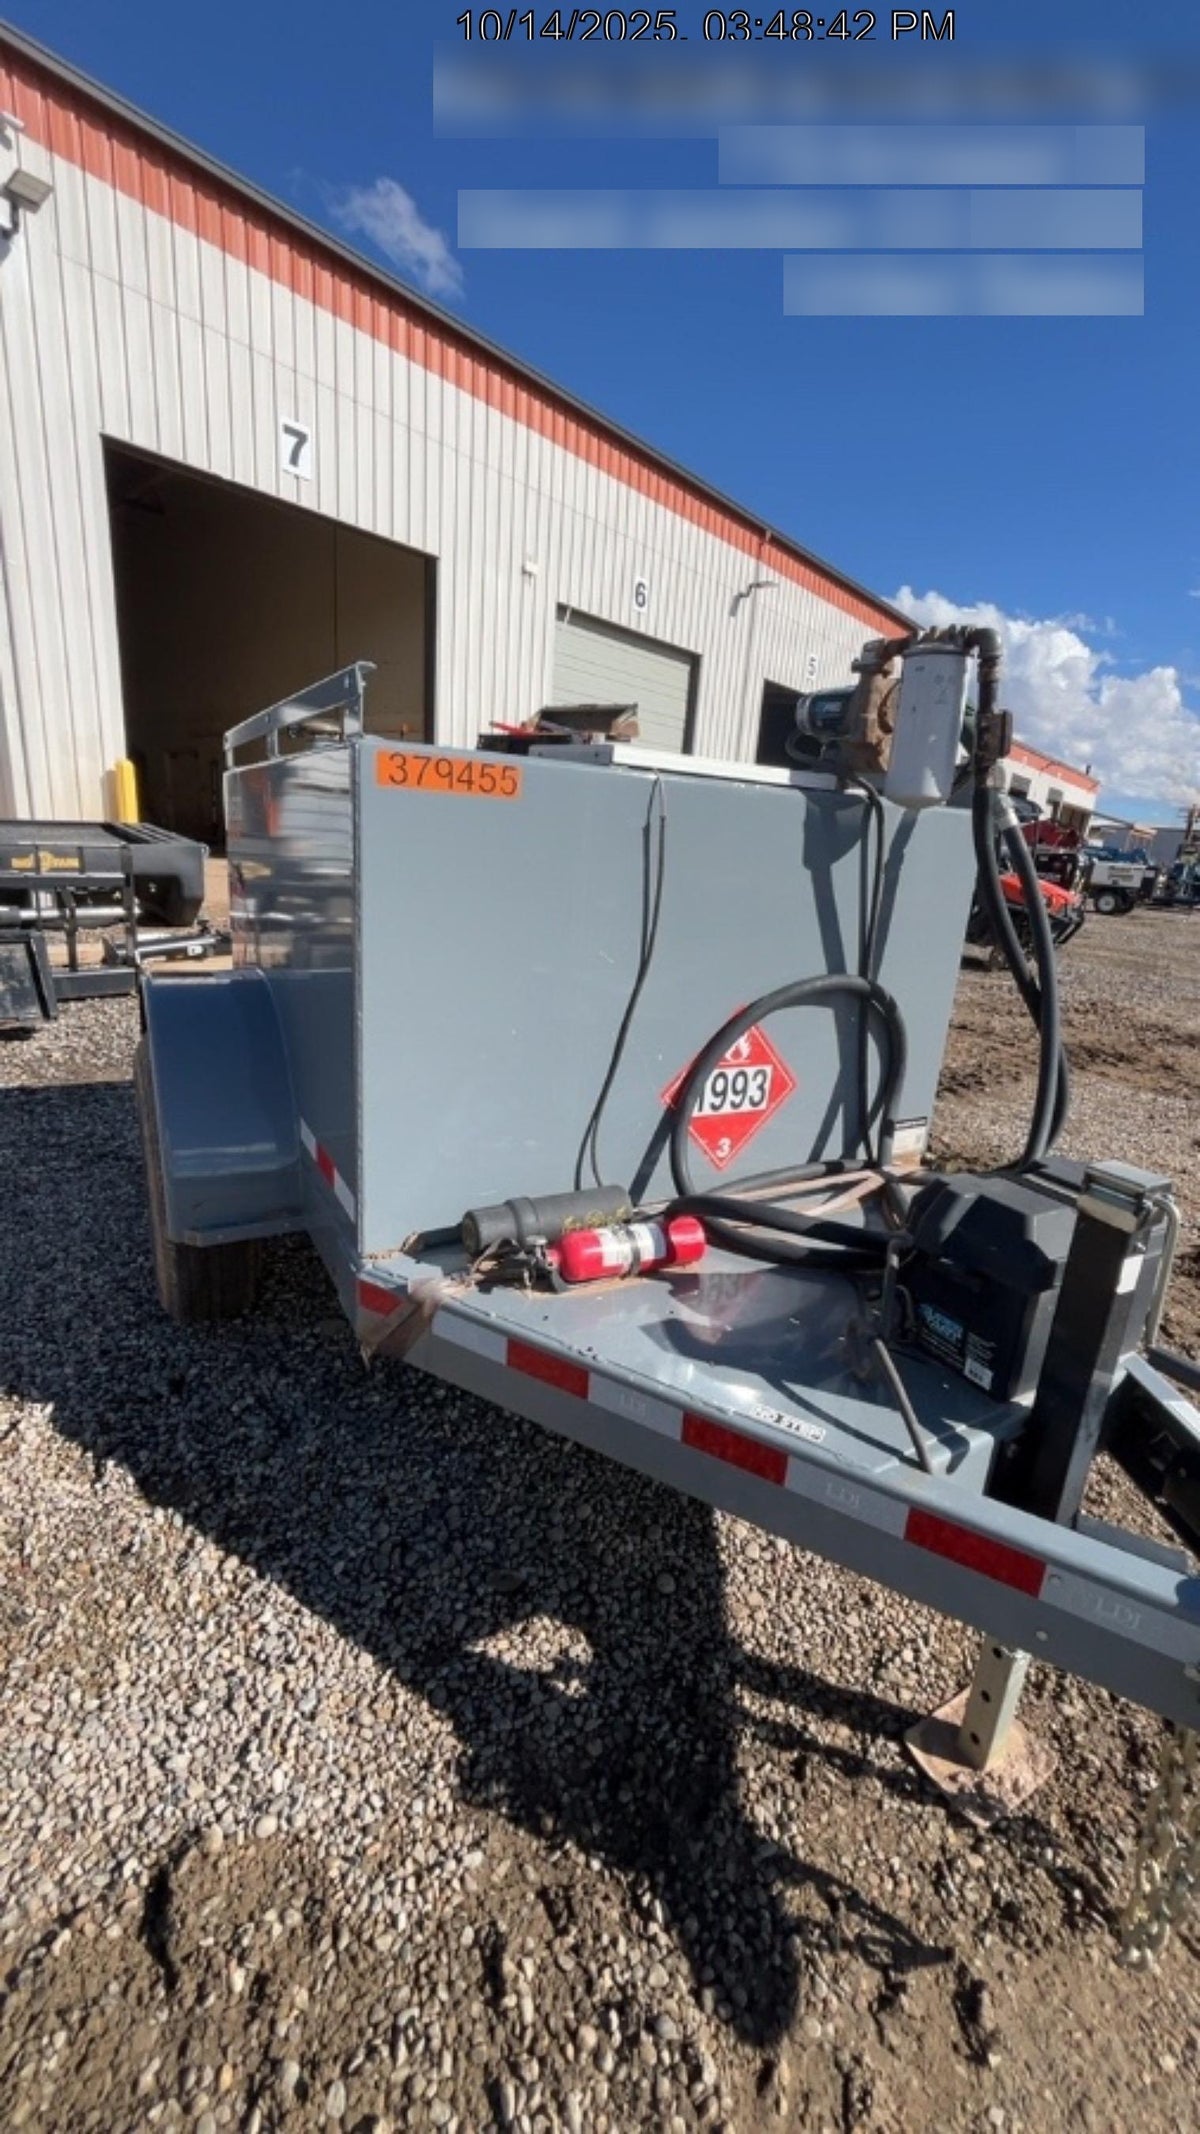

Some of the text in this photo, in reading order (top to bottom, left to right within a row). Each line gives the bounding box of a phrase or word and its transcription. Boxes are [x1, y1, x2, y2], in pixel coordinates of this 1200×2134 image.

[283, 423, 308, 467] 7
[635, 582, 646, 608] 6
[388, 752, 518, 796] 379455
[715, 1137, 732, 1158] 3
